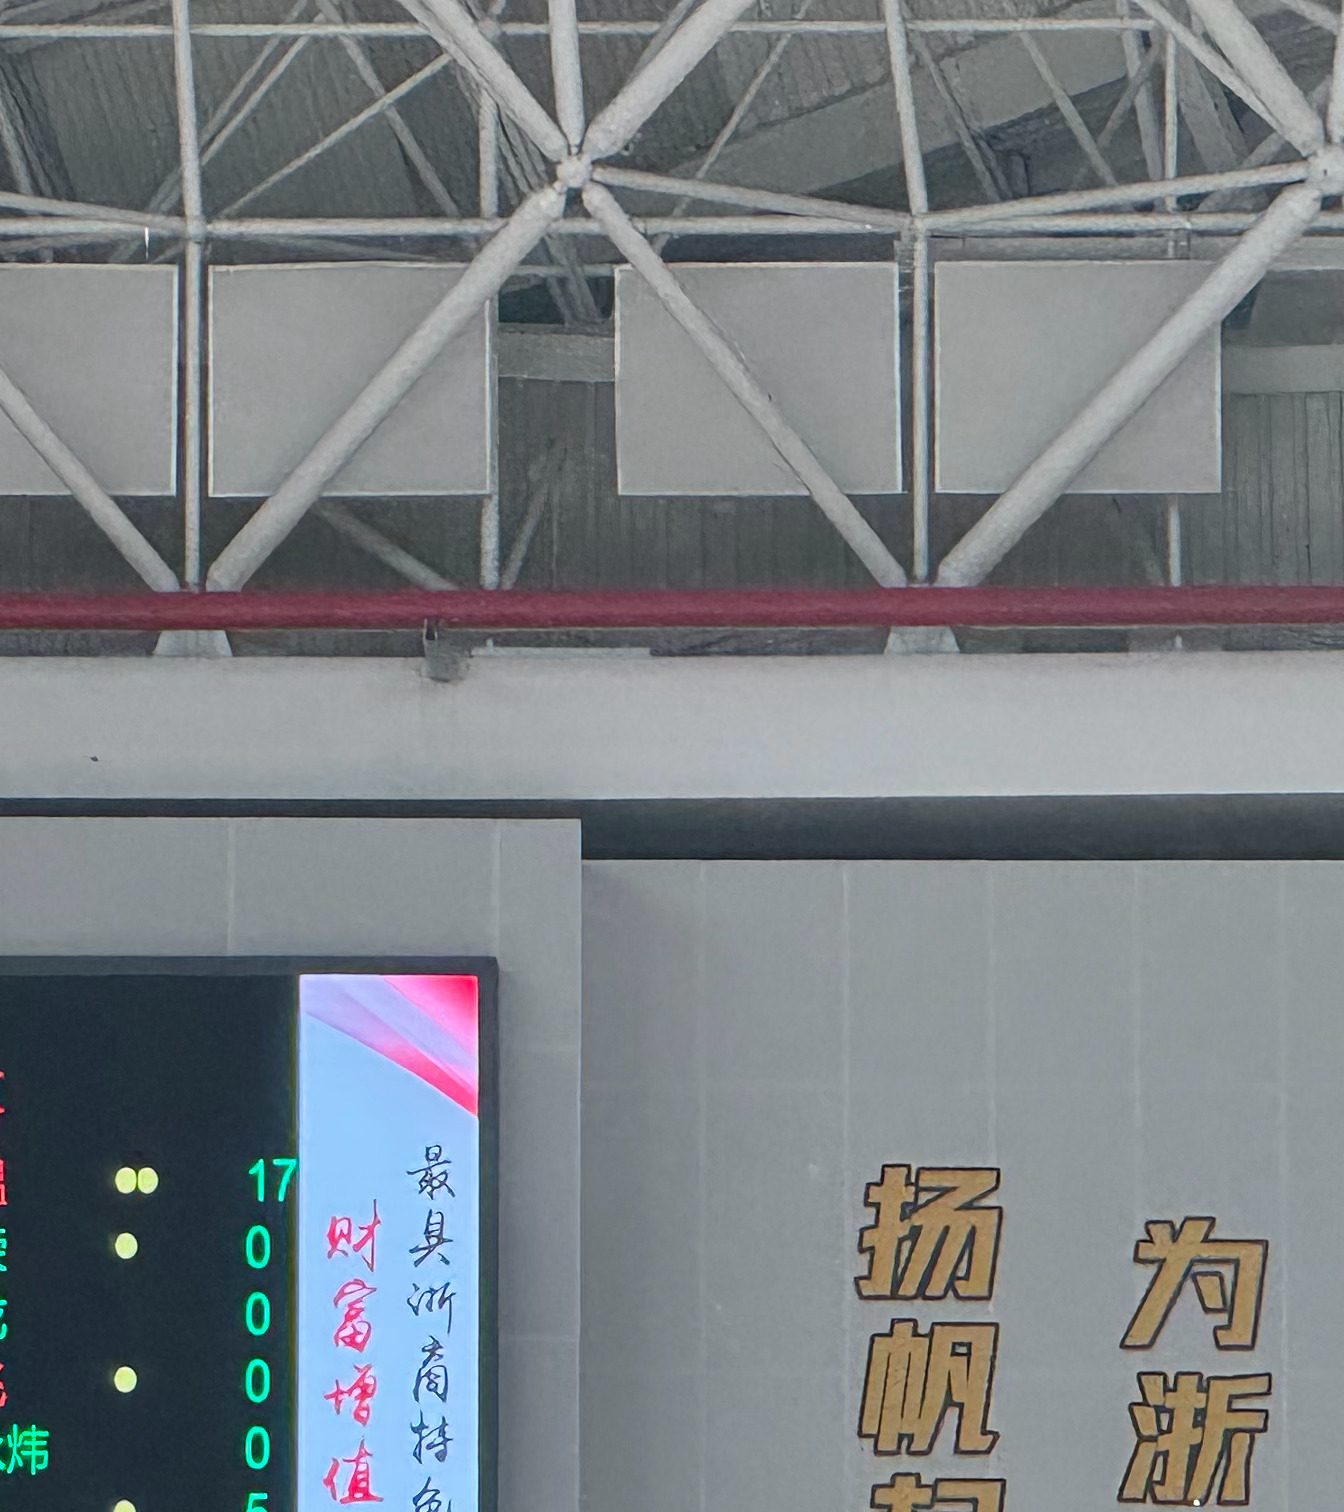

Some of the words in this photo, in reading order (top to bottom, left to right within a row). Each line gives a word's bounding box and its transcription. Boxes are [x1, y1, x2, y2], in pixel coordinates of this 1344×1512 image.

[248, 1158, 297, 1202] 17
[246, 1225, 272, 1270] 0
[246, 1292, 271, 1336] 0
[245, 1359, 271, 1403] 0
[245, 1426, 270, 1470] 0
